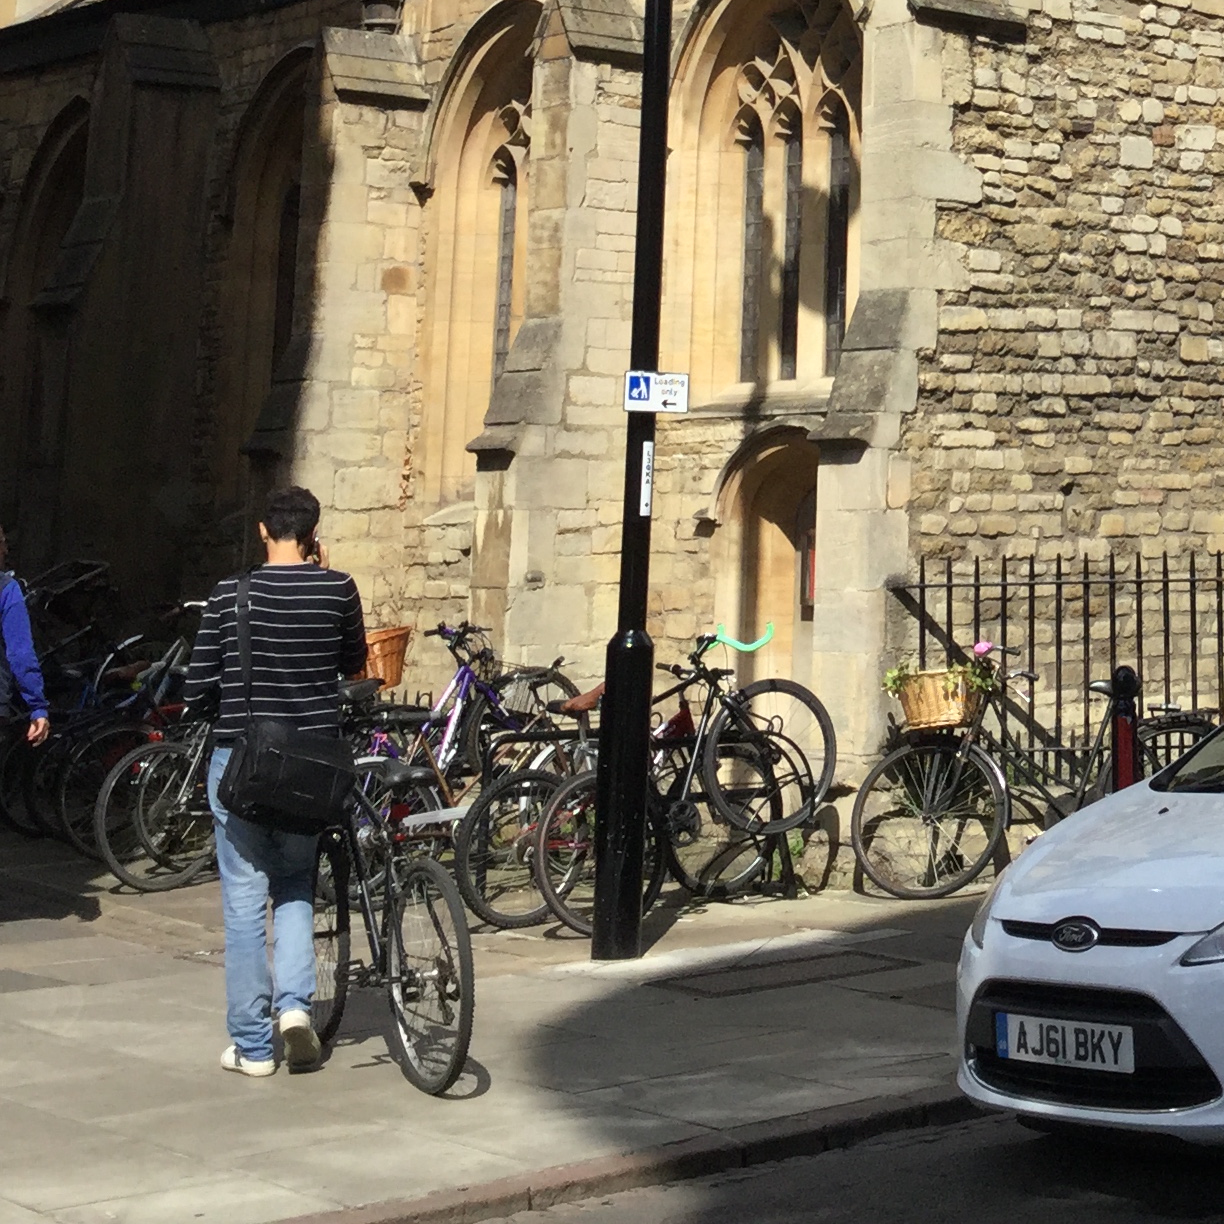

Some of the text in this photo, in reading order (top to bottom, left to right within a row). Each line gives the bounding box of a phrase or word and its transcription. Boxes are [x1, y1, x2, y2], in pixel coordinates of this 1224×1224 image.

[654, 377, 685, 387] Loading
[661, 388, 677, 396] only
[1058, 926, 1086, 942] Ford
[1017, 1021, 1123, 1065] AJ61 BKY
